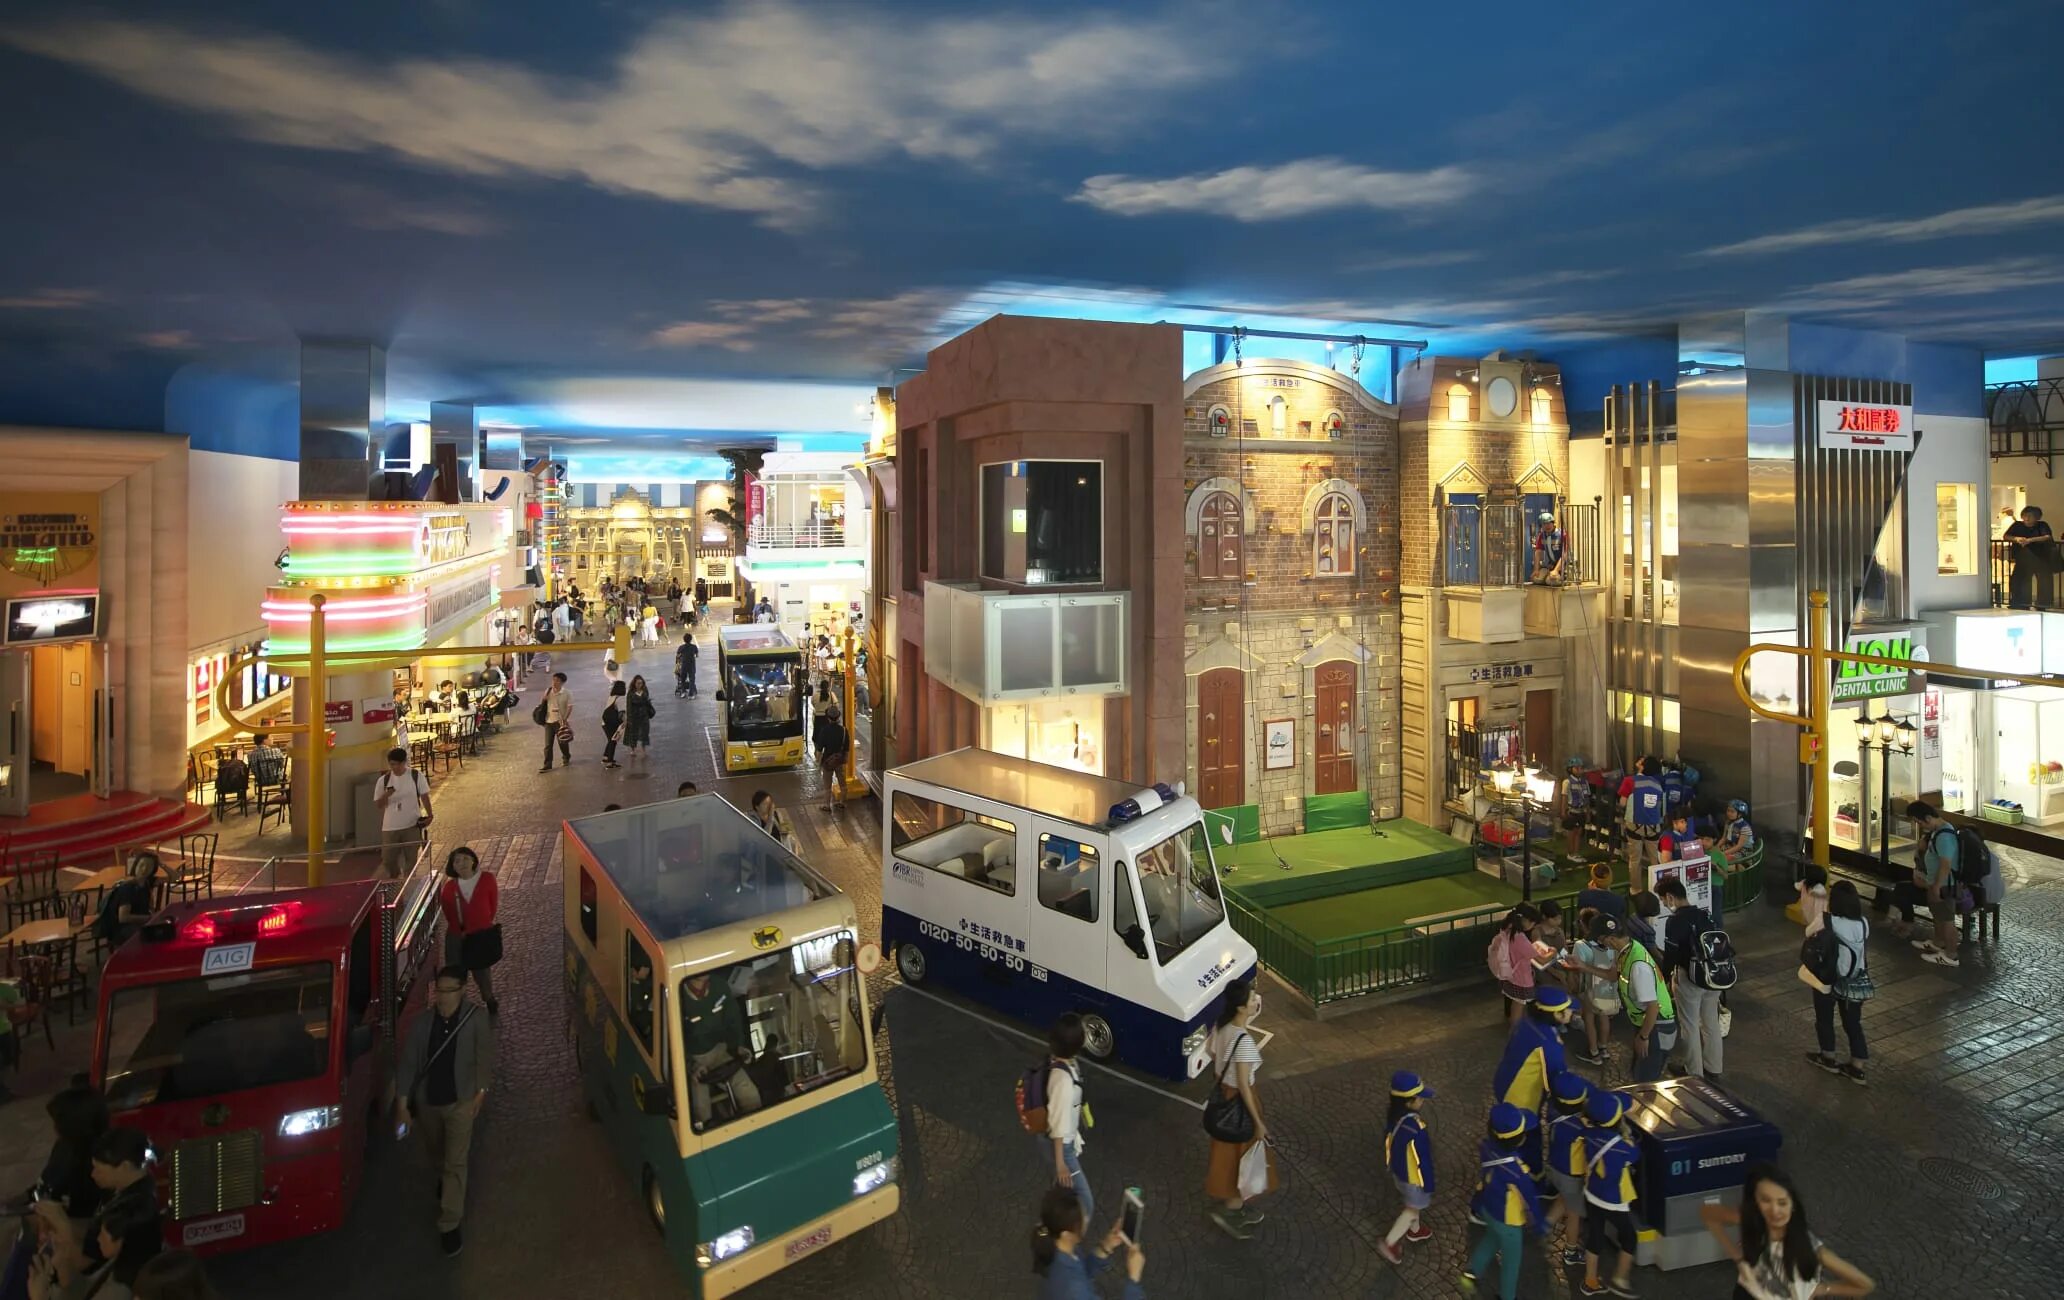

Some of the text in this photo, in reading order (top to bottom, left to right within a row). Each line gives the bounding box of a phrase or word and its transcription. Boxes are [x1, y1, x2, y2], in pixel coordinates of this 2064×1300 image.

[1838, 405, 1902, 433] 大和証券
[1840, 637, 1911, 678] LION
[1481, 664, 1533, 681] 生活救急車
[1835, 677, 1906, 697] DENTAL CLINIC
[919, 920, 1025, 973] 0120-50-50-50
[970, 921, 1026, 953] 生活救急車
[211, 950, 244, 967] AIG
[1698, 1152, 1747, 1169] SUNTORY
